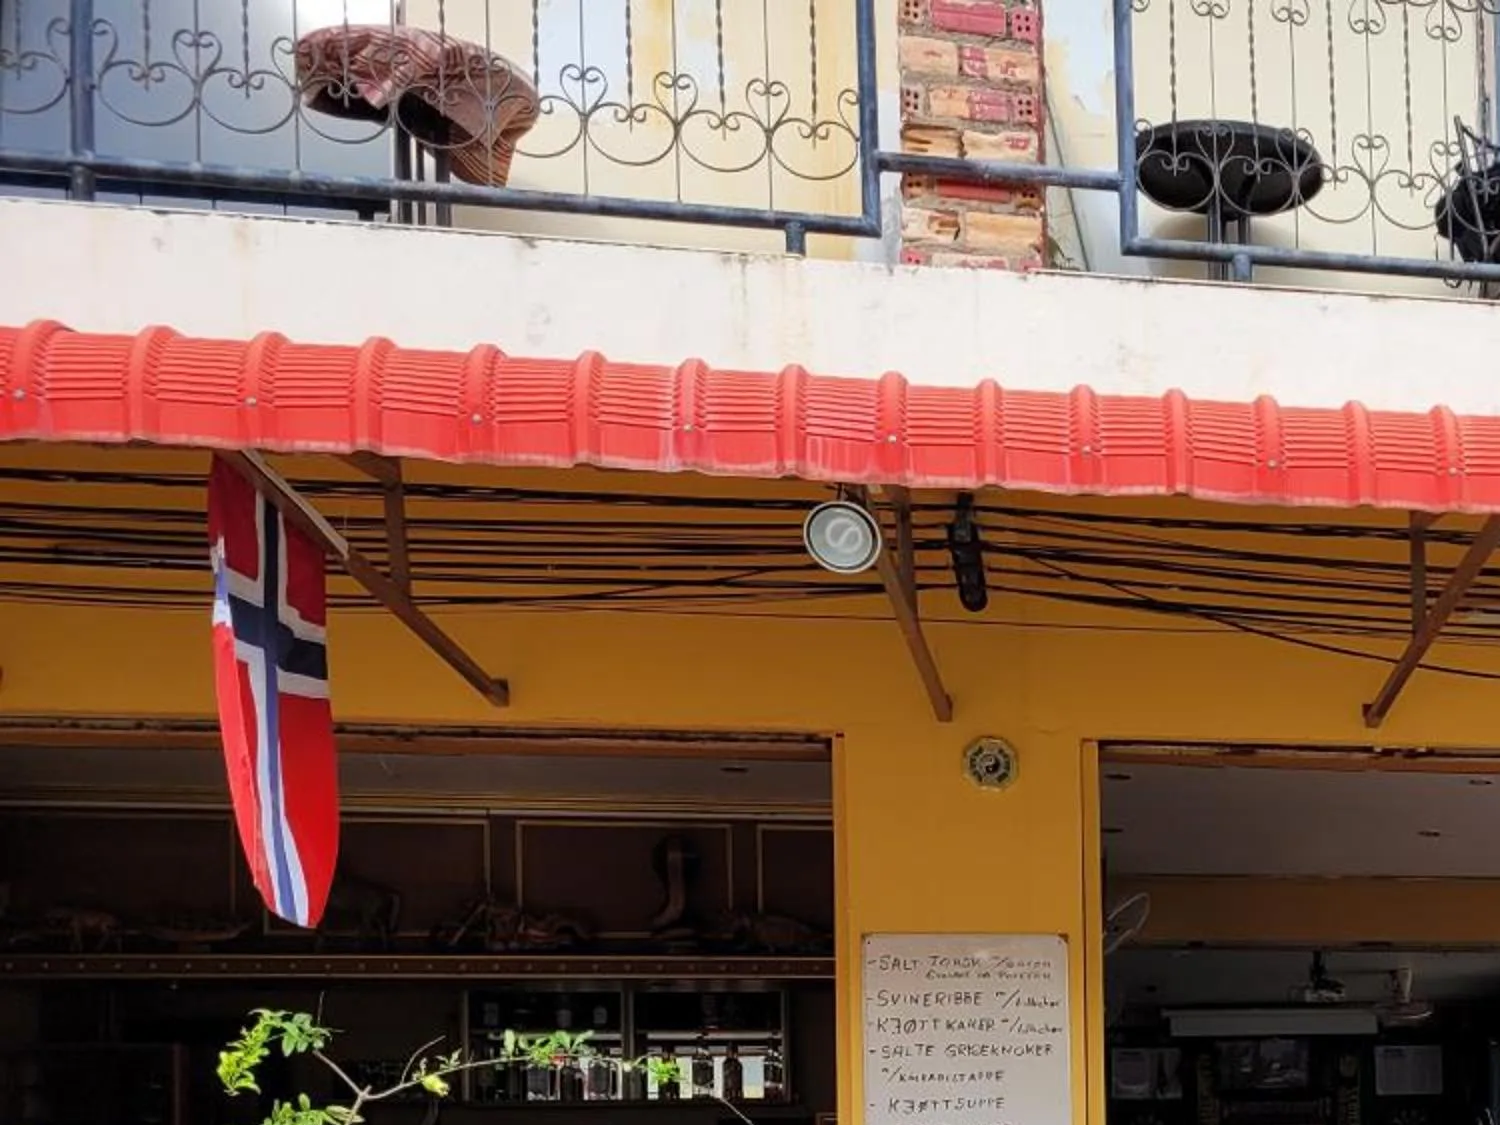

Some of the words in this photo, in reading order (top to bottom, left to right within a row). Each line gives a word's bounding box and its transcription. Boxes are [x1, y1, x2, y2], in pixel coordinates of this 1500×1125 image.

[879, 954, 920, 971] SALT
[876, 989, 985, 1007] SVINERIBBE
[881, 1043, 936, 1060] SALTE
